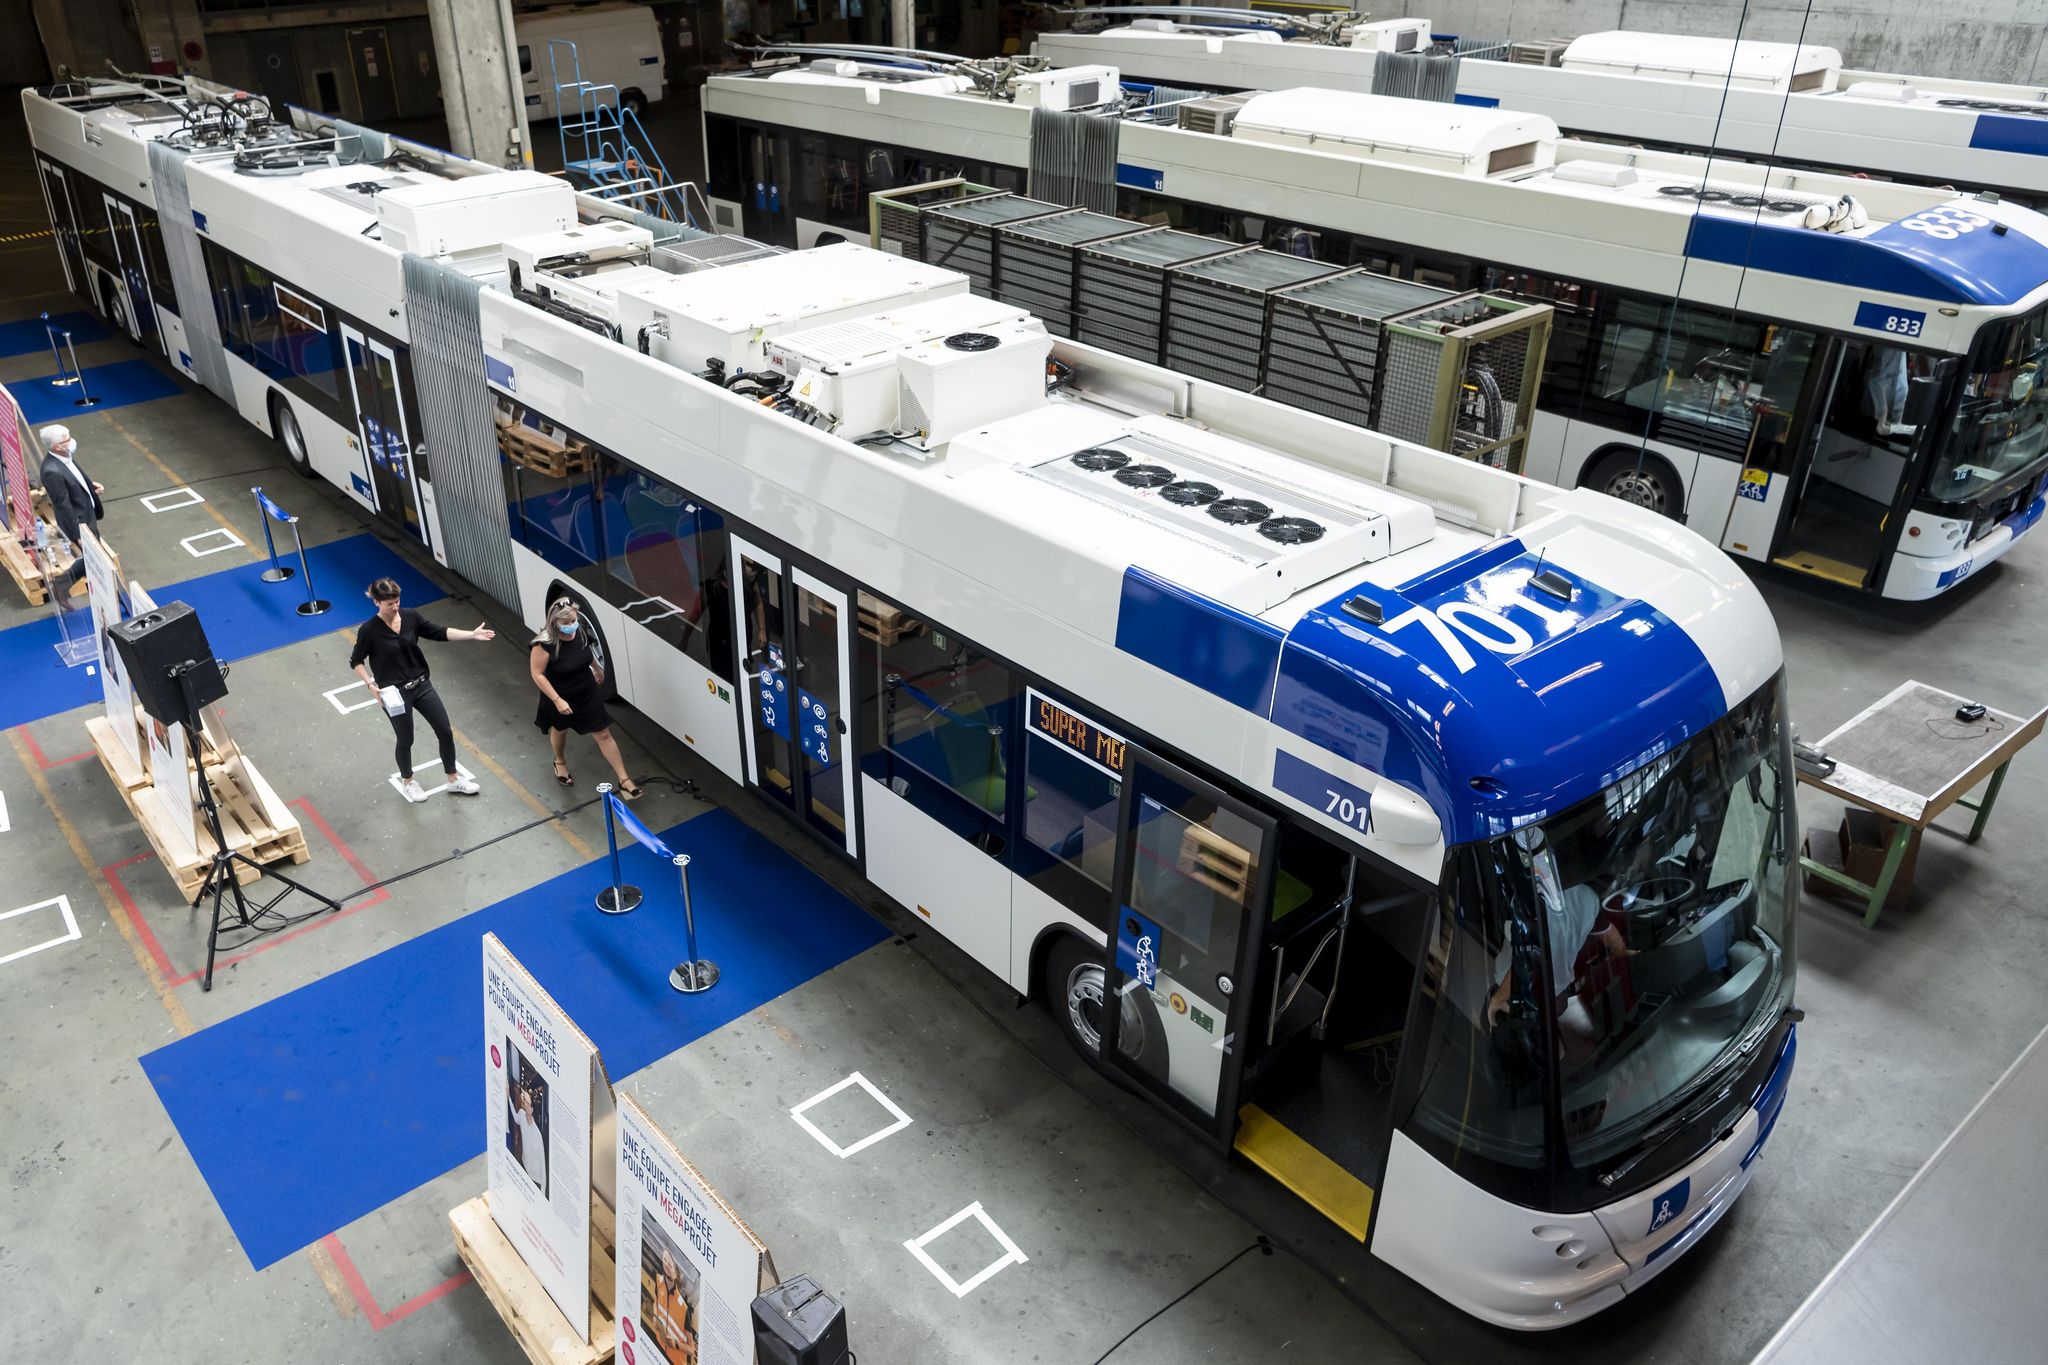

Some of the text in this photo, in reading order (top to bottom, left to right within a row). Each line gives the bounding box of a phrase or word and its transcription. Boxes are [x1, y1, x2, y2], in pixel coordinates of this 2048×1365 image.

[1900, 207, 1990, 240] 833
[1885, 315, 1921, 336] 833
[1378, 590, 1570, 675] 701
[1040, 700, 1087, 751] SUPER
[1325, 788, 1368, 830] 701
[488, 966, 501, 992] UNE
[502, 981, 525, 1019] ÉQUIPE
[526, 1010, 557, 1056] ENGAGÉE
[488, 985, 506, 1015] POUR
[506, 1005, 516, 1026] UN
[517, 1018, 560, 1078] MEGAPROJET
[622, 1128, 639, 1159] UNE
[640, 1147, 671, 1196] ÉQUIPE
[672, 1186, 713, 1244] ENGAGÉE
[622, 1149, 645, 1185] POUR
[646, 1177, 658, 1201] UN
[660, 1191, 718, 1269] MEGAPROJET
